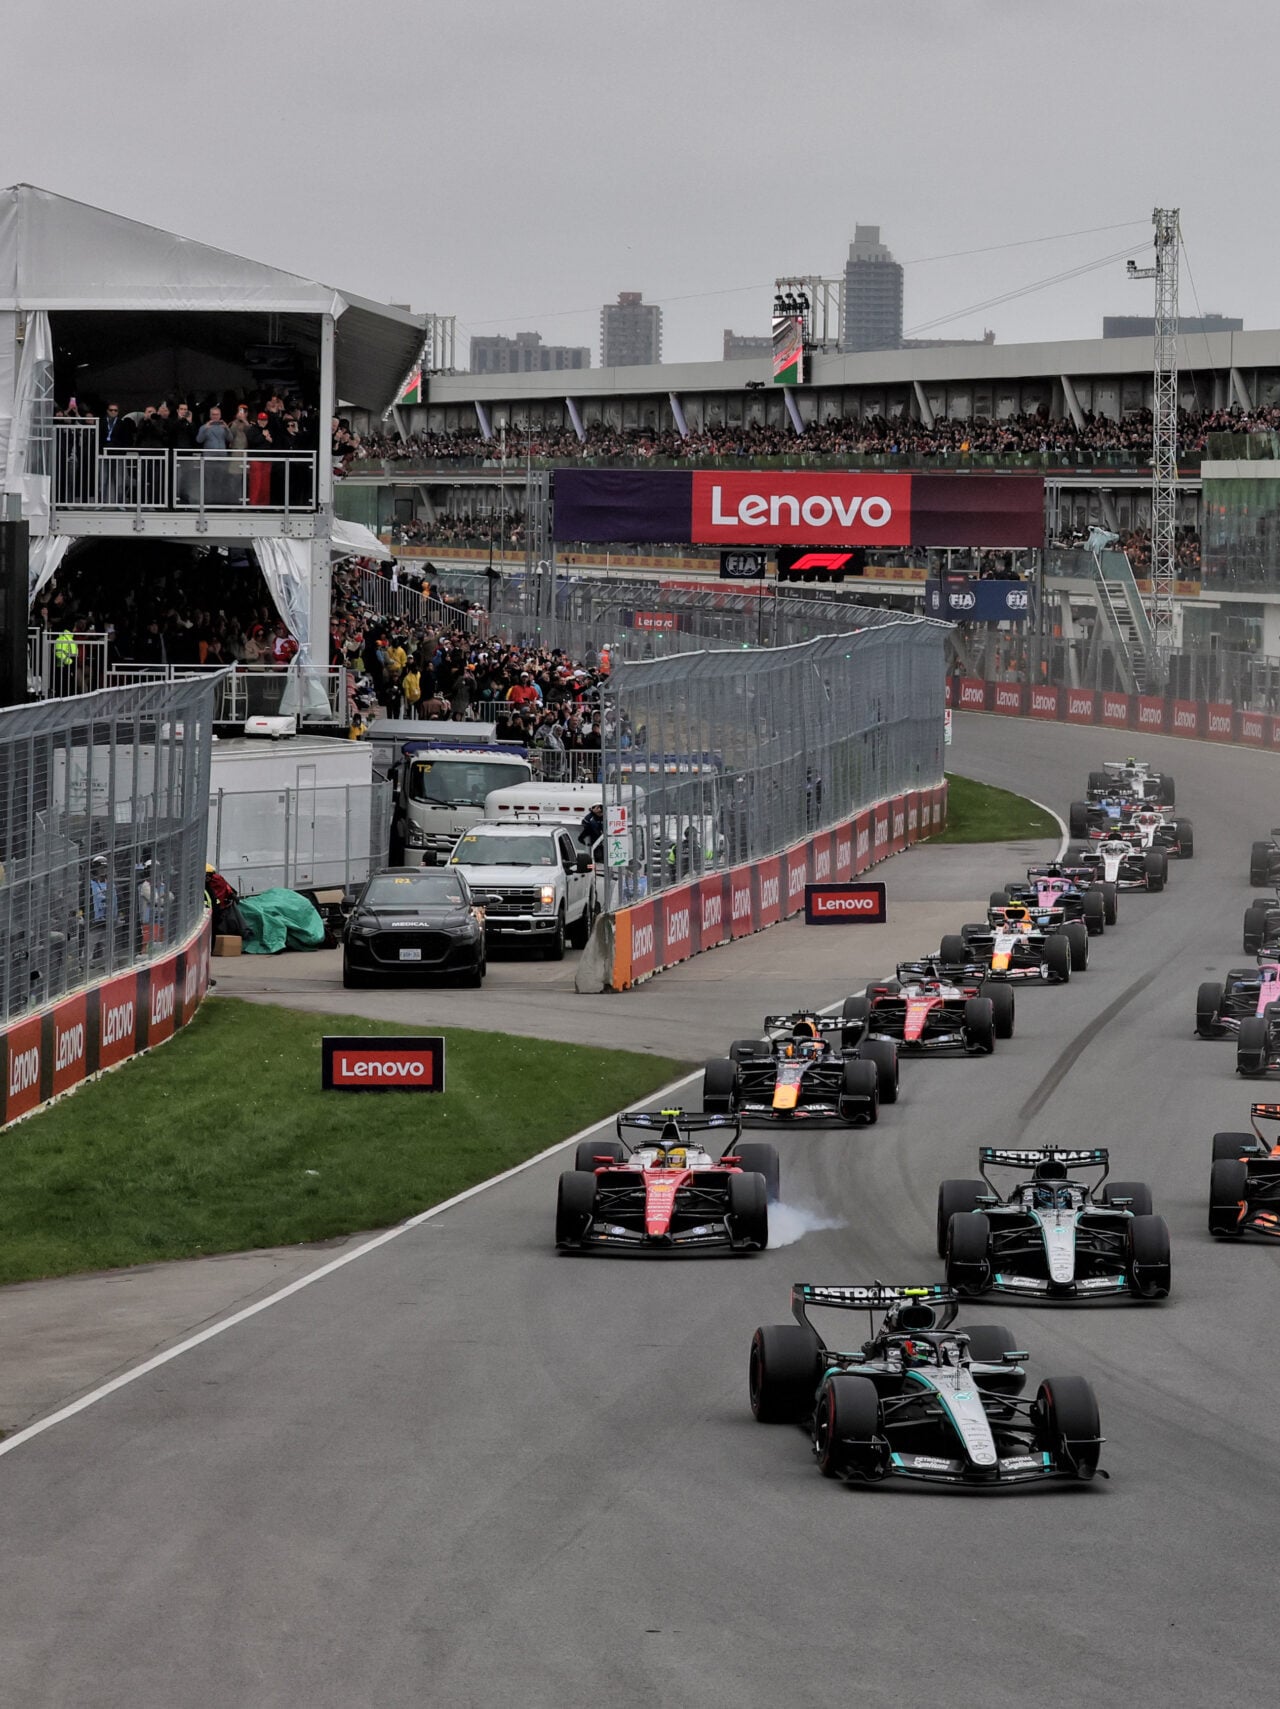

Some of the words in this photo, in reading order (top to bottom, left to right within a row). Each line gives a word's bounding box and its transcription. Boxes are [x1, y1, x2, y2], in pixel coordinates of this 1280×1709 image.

[711, 485, 891, 527] Lenovo
[638, 615, 673, 628] Lenovo
[961, 684, 984, 702] Lenovo
[997, 687, 1019, 707] Lenovo
[1032, 691, 1056, 711] Lenovo
[1069, 696, 1092, 716] Lenovo
[1104, 699, 1126, 719] Lenovo
[1140, 704, 1162, 724] Lenovo
[1174, 709, 1196, 728] Lenovo
[1208, 711, 1231, 733] Lenovo
[1243, 716, 1263, 738] Lenovo
[609, 820, 626, 828] FIRE
[815, 848, 830, 880] Lenovo
[837, 838, 850, 870] Lenovo
[760, 875, 779, 909] Lenovo
[788, 862, 806, 896] Lenovo
[702, 892, 722, 930] Lenovo
[731, 885, 751, 920] Lenovo
[817, 897, 874, 910] Lenovo
[667, 907, 690, 945] Lenovo
[632, 924, 654, 960] Lenovo
[151, 982, 175, 1026] Lenovo
[103, 1000, 134, 1047] Lenovo
[56, 1022, 84, 1072] Lenovo
[10, 1046, 39, 1097] Lenovo
[341, 1057, 425, 1077] Lenovo
